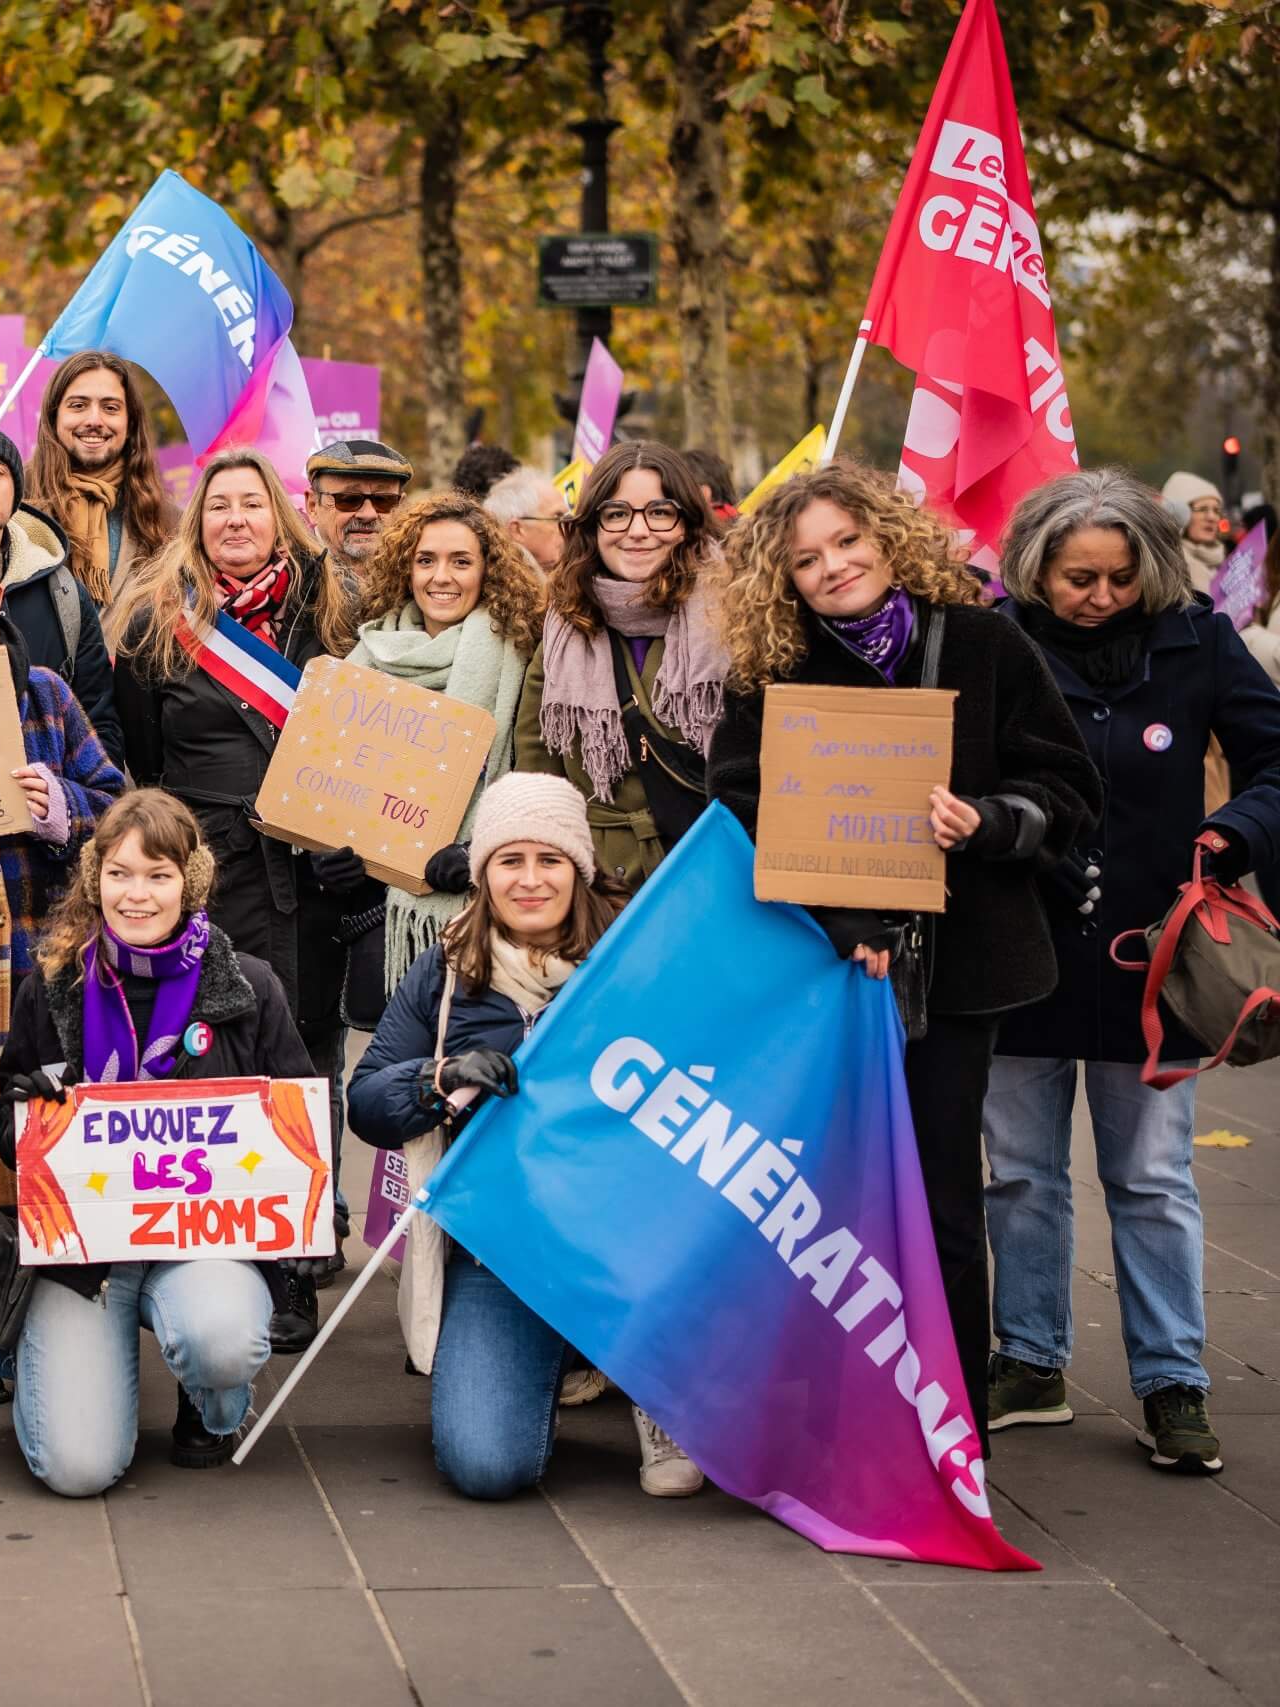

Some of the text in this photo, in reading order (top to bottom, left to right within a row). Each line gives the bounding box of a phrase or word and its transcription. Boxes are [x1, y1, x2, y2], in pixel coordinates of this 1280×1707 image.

[331, 688, 457, 754] OVARES
[295, 766, 429, 829] CONTRE TOUS
[867, 858, 934, 880] PARDON
[192, 1028, 208, 1051] G
[83, 1104, 239, 1145] EDUQUEZ
[132, 1148, 213, 1195] LES
[130, 1194, 295, 1252] ZHOMS
